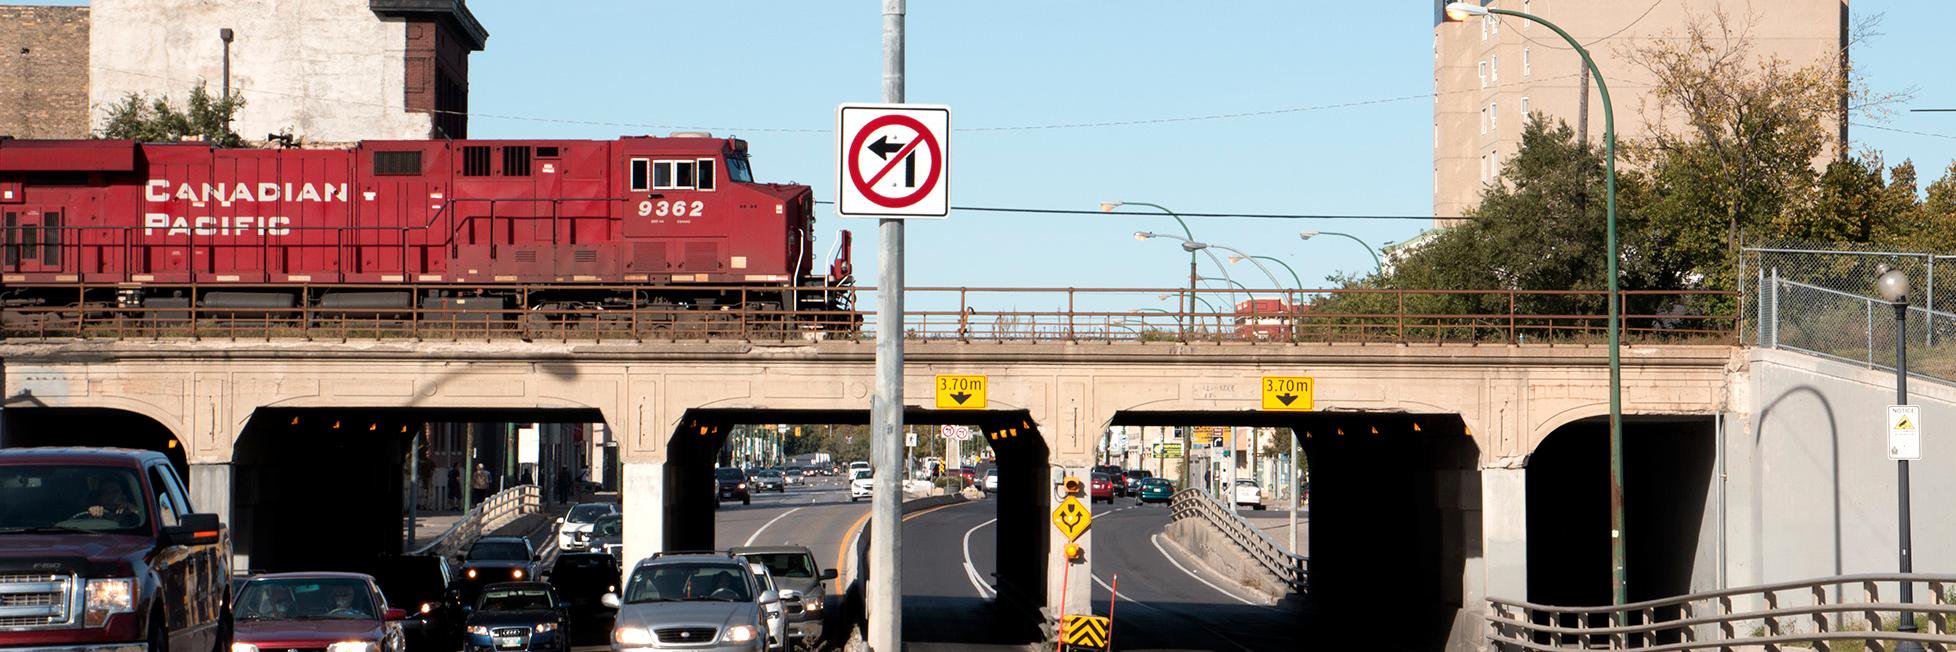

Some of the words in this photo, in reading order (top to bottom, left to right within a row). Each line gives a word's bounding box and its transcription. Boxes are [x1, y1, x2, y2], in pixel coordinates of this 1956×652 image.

[145, 178, 347, 203] CANADIAN
[638, 200, 704, 217] 9362
[145, 213, 291, 236] PACIFIC
[940, 378, 982, 390] 3.70m
[1266, 379, 1308, 392] 3.70m
